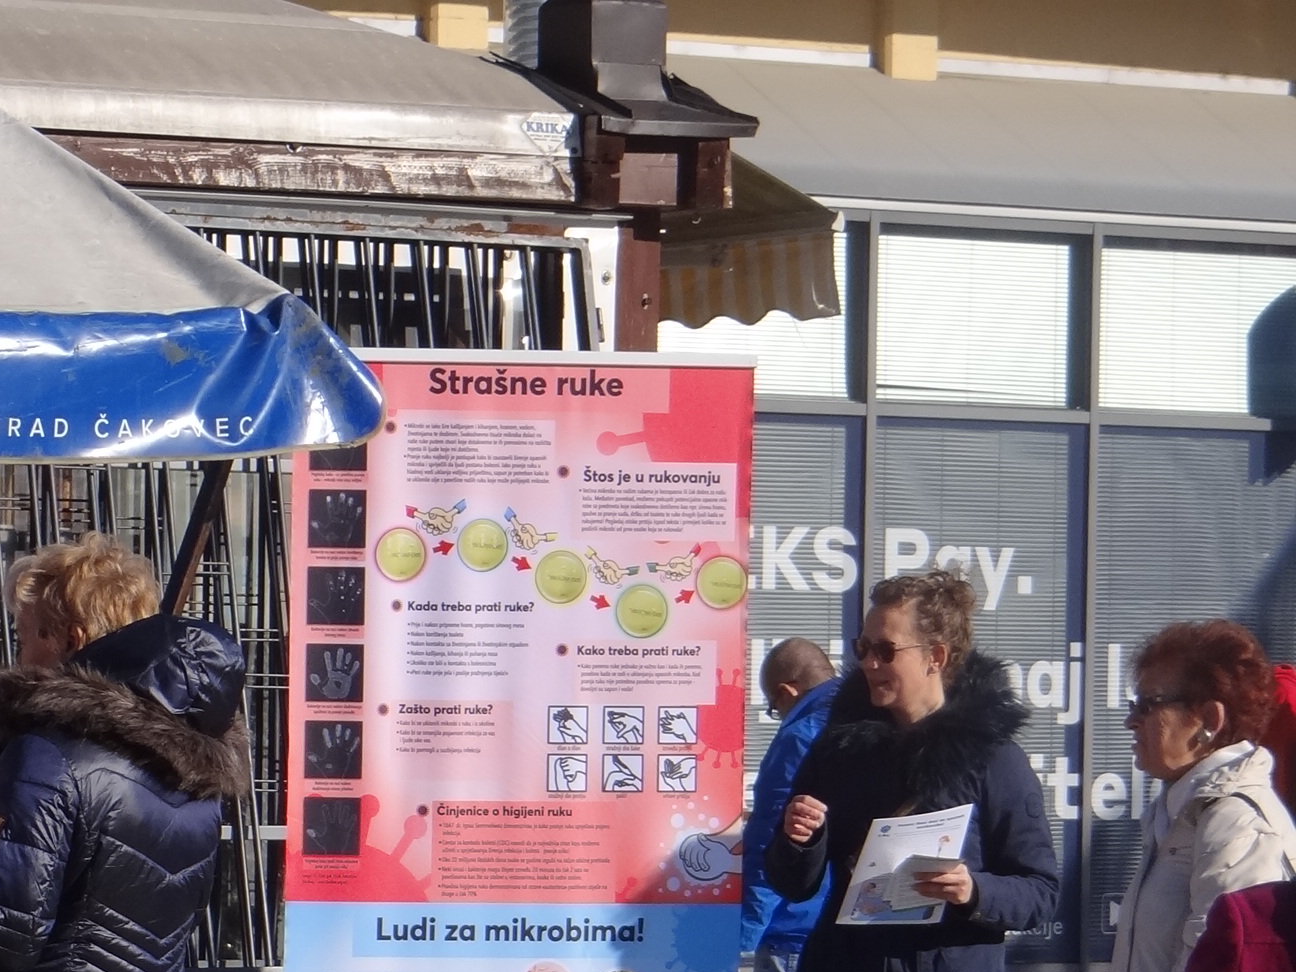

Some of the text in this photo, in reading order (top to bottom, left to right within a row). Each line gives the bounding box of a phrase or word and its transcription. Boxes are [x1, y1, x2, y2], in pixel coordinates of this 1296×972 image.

[429, 367, 624, 397] Strašne ruke
[94, 414, 255, 439] ČAKOVEC
[583, 465, 721, 487] Štos je u rukovanju
[748, 526, 857, 593] KS
[407, 601, 535, 614] Kada treba prati ruke?
[577, 645, 701, 658] Kako treba prati ruke?
[398, 703, 493, 717] Zašto prati ruke?
[436, 803, 573, 819] Činjenice o higijeni ruku
[376, 917, 645, 943] Ludi za mikrobima!
